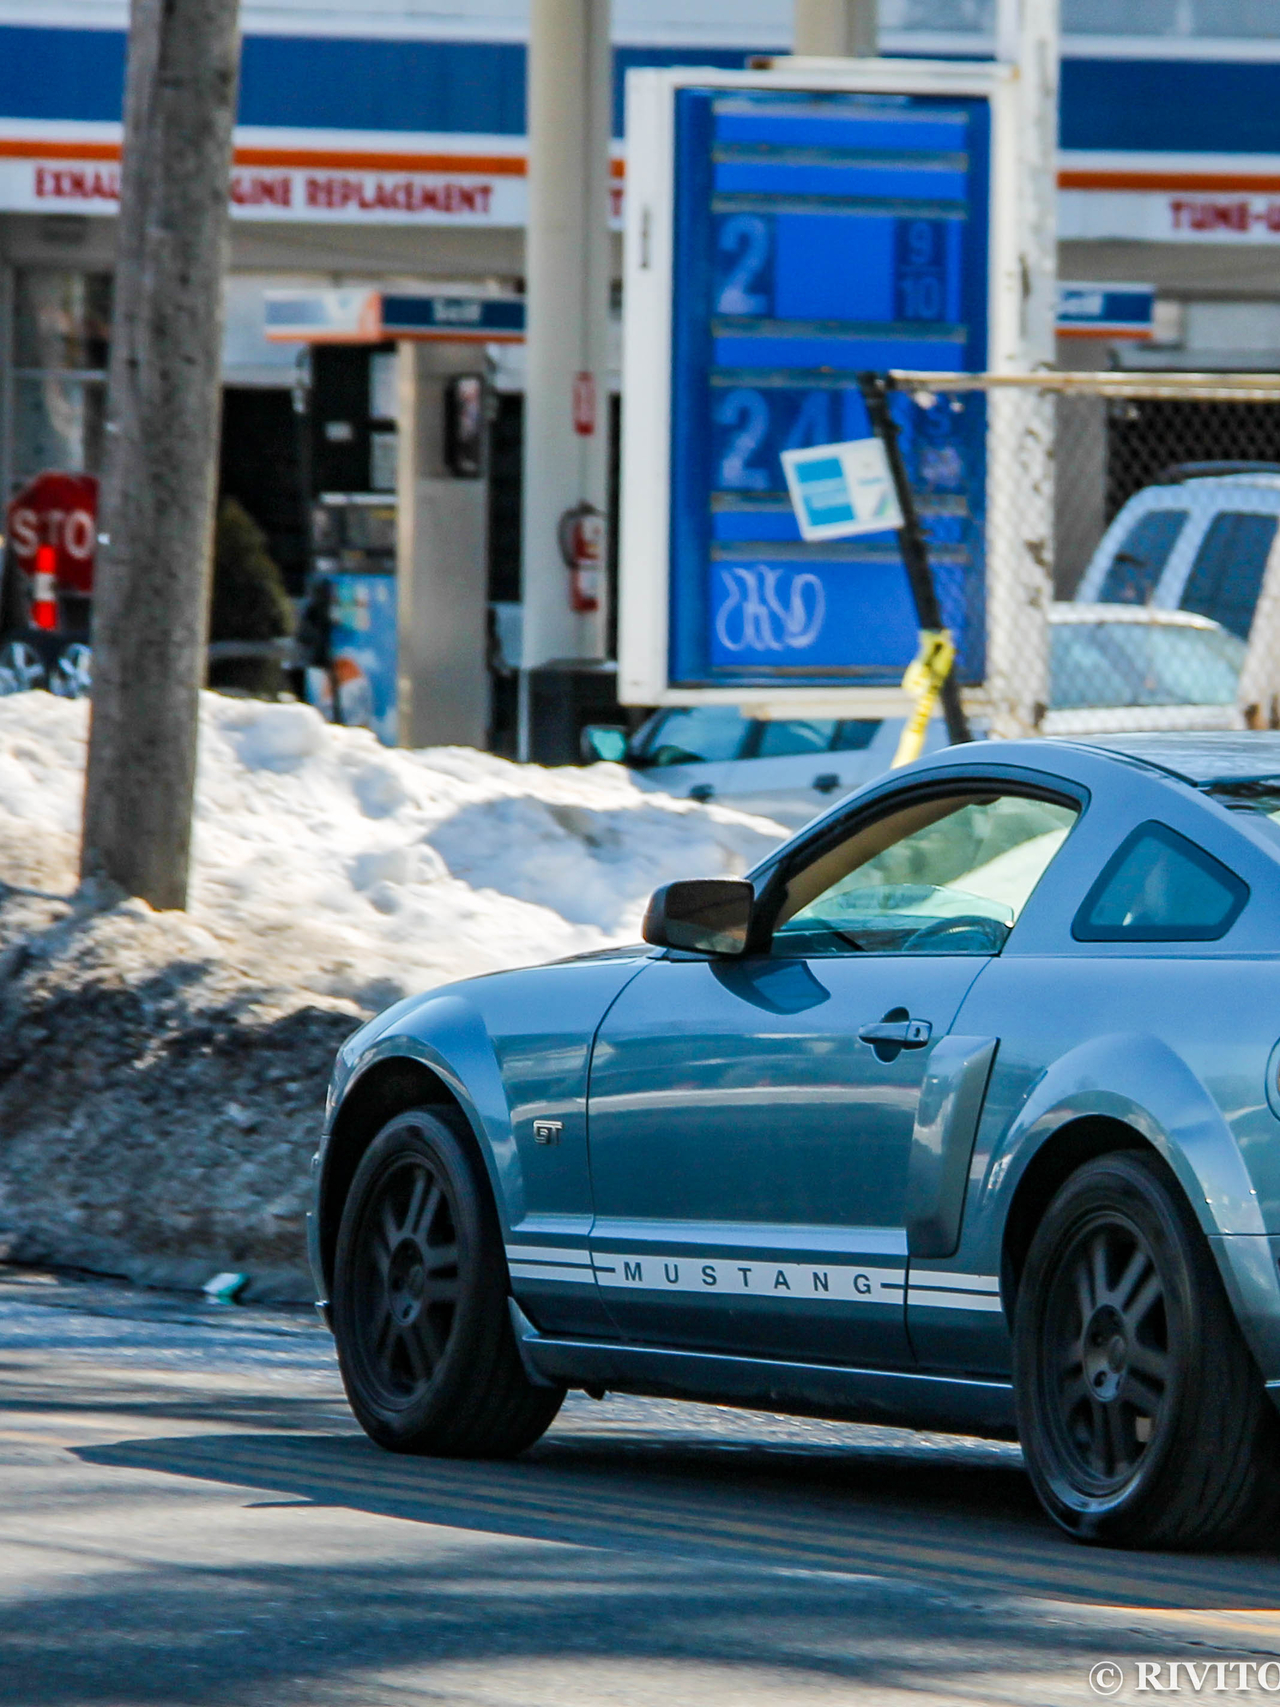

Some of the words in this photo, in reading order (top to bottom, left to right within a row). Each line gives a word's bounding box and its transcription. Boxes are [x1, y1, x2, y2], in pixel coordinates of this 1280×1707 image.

[231, 177, 291, 207] GINE
[305, 178, 493, 213] REPLACEMENT
[717, 214, 768, 315] 2
[13, 509, 96, 558] STO
[533, 1120, 564, 1145] GT
[624, 1261, 872, 1295] MUSTANG
